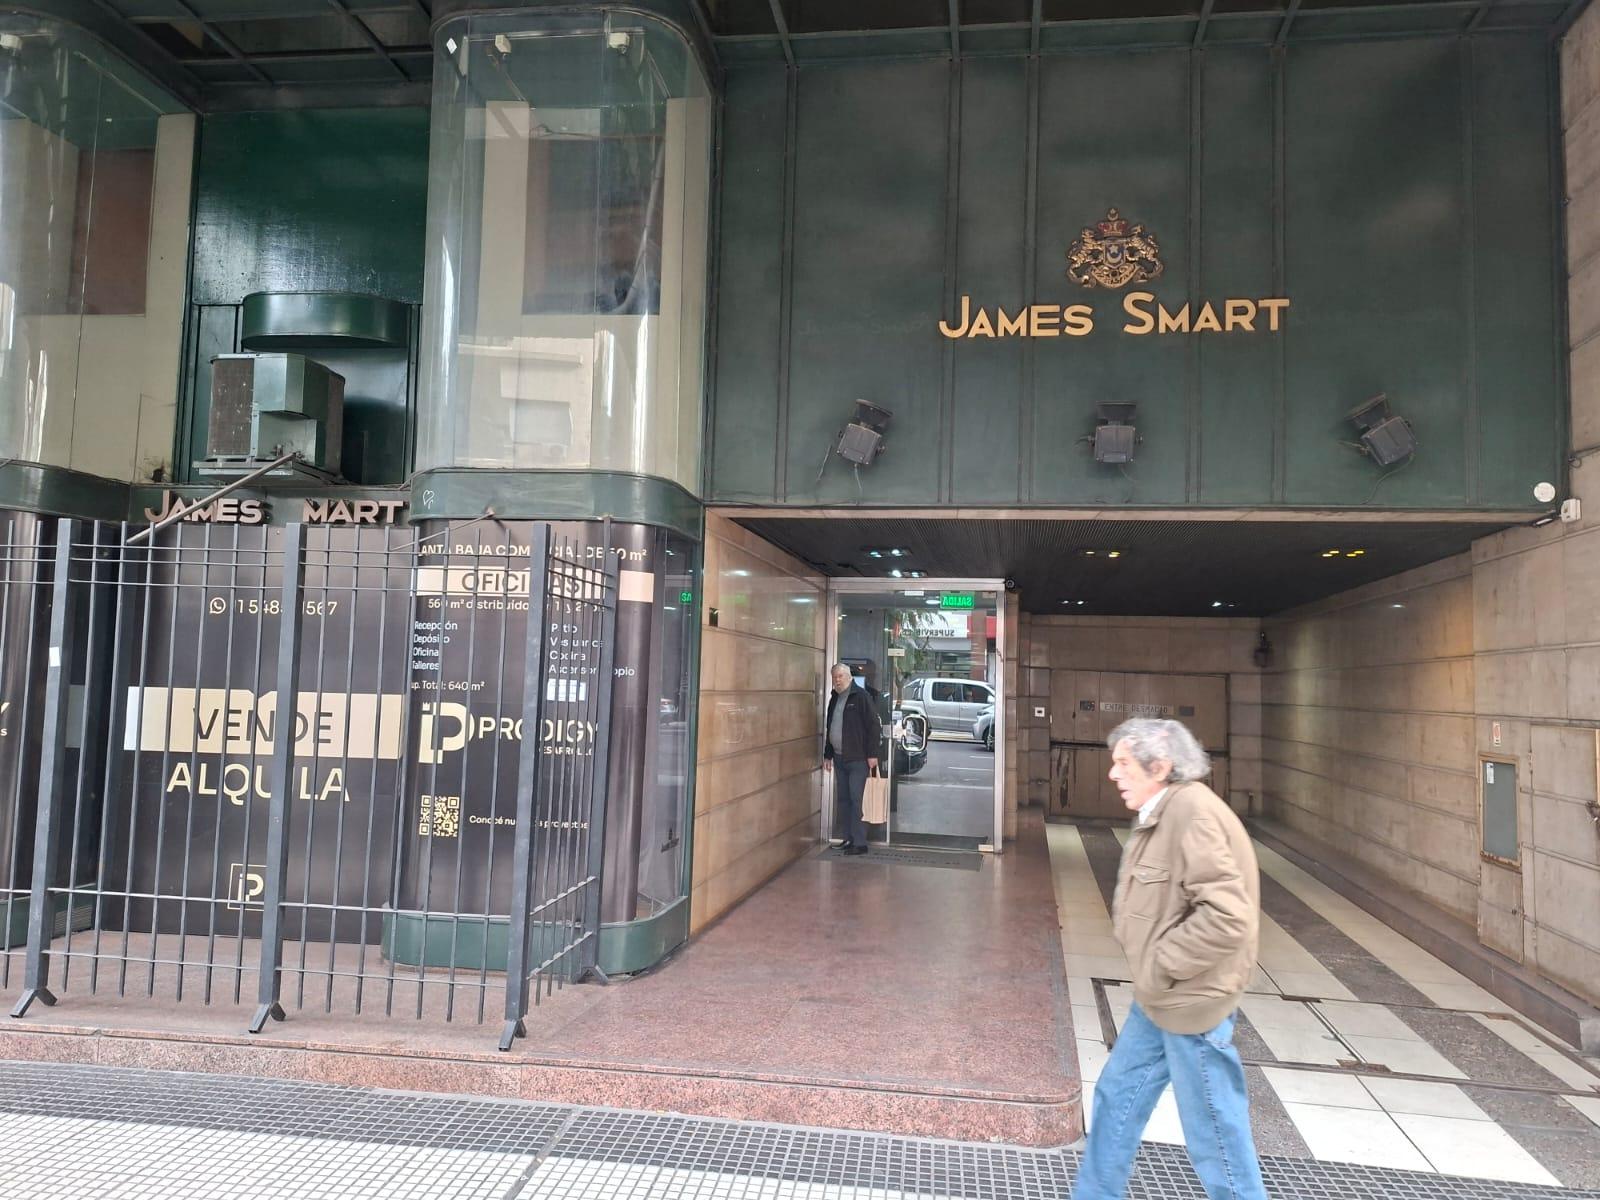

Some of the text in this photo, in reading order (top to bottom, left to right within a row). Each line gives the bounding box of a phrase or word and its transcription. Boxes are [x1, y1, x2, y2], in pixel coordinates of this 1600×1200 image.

[939, 291, 1290, 338] JAMES SMART
[144, 489, 263, 523] JAMES
[461, 572, 580, 594] OFICIAS
[414, 621, 458, 632] Recepcón
[551, 623, 578, 634] Ptio
[413, 633, 450, 645] Depósio
[448, 681, 470, 692] 640
[193, 708, 333, 744] VENDE
[166, 762, 350, 805] ALQULA
